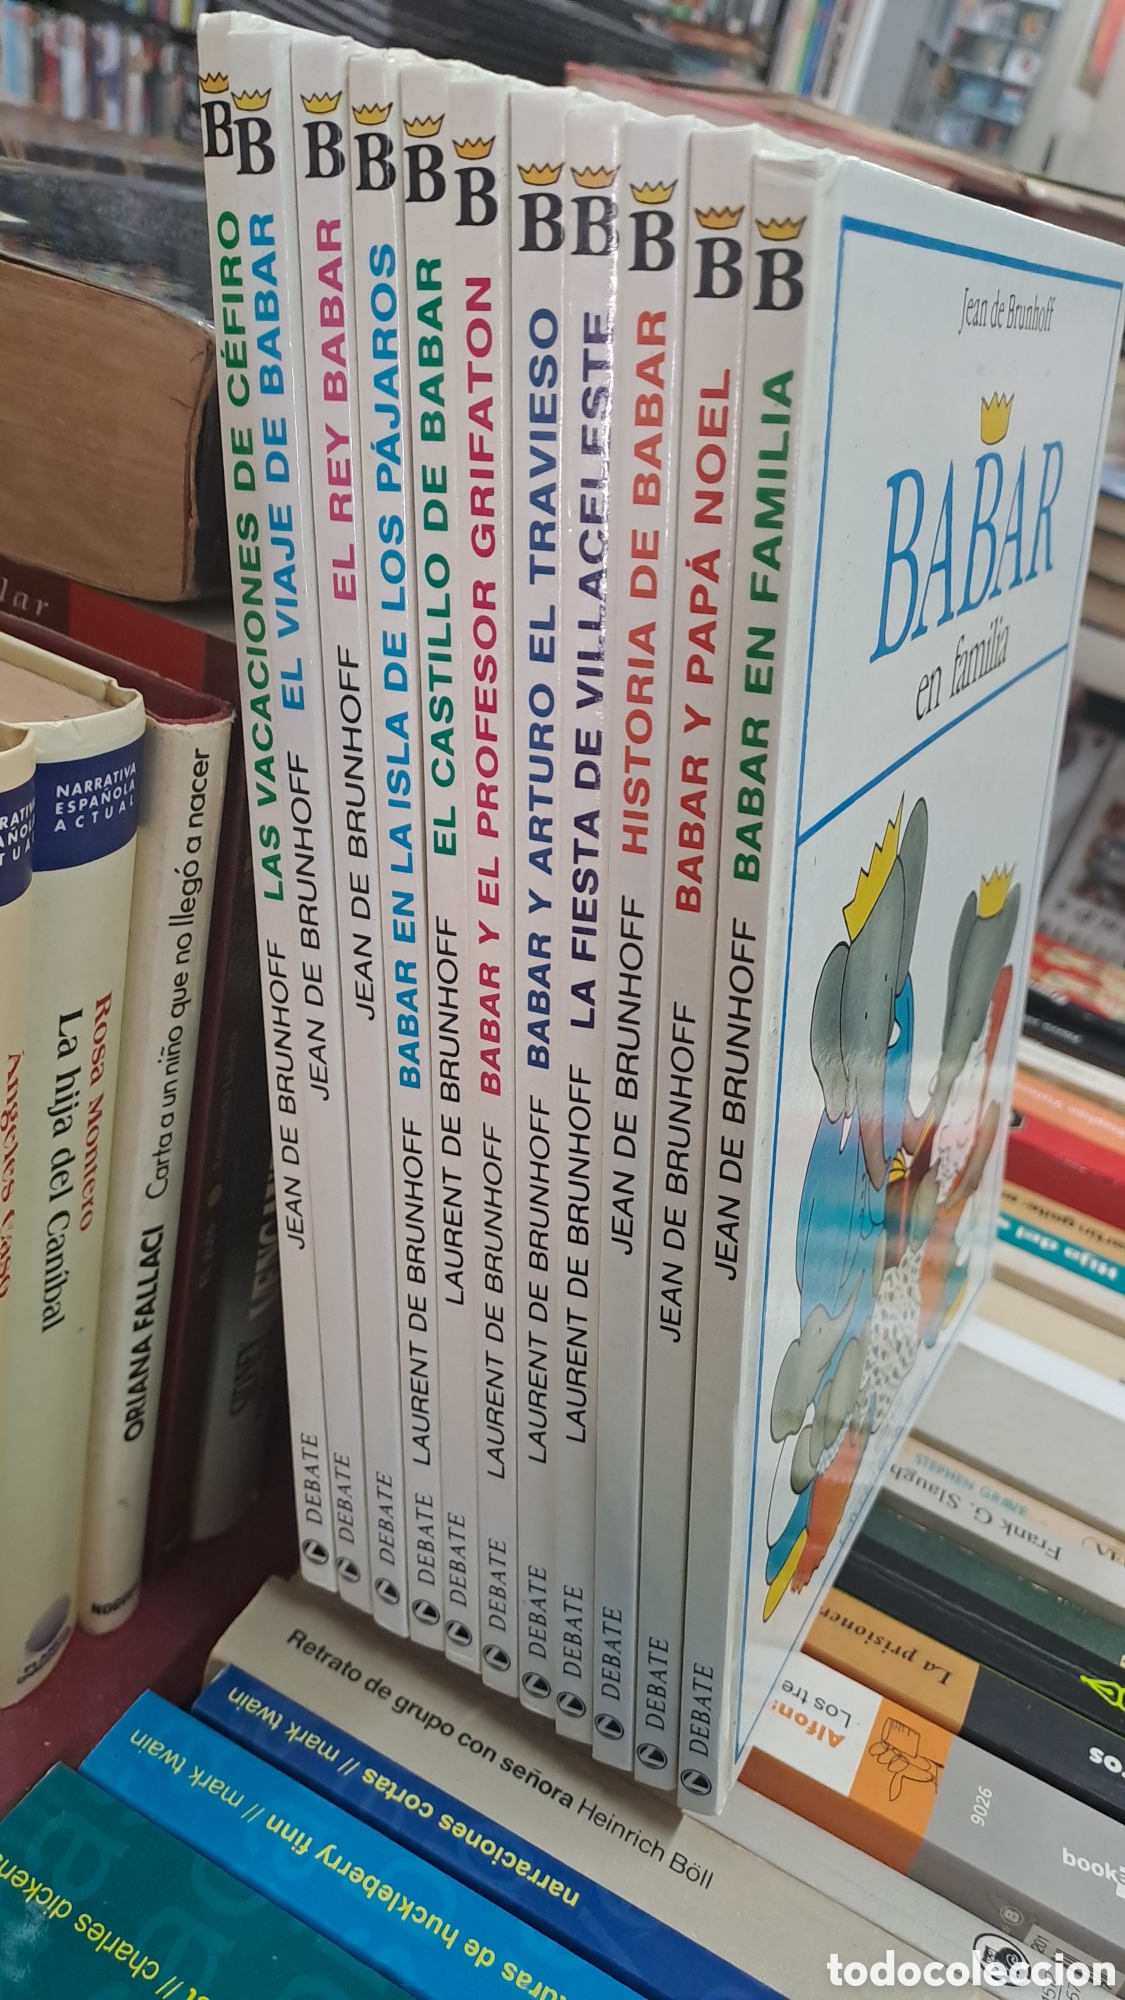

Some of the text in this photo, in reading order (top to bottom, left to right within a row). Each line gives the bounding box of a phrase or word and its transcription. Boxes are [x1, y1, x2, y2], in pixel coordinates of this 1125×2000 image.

[234, 118, 275, 175] B
[455, 167, 498, 226] B
[693, 237, 742, 298] B
[316, 218, 357, 601] EL REY BABAR
[957, 287, 1056, 336] Jean de Brunhoff
[217, 211, 285, 901] LAS VACACIONES DE CÉFIRO
[249, 213, 306, 711] EL VIAJE DE BABAR
[416, 258, 457, 856] EL CASTILLO DE BABAR
[622, 310, 666, 855] HISTORIA DE BABAR
[869, 440, 1064, 664] BABAR
[369, 244, 421, 1089] BABAR EN LA ISLA DE LOS PÁJAROS
[465, 277, 501, 1096] BABAR Y EL PROFESOR GRIFATON
[527, 308, 559, 1069] BABAR Y ARTURO EL TRAVIESO
[570, 312, 615, 1029] LA FIESTA DE VILLACELESTE
[676, 368, 730, 913] BABAR Y PAPÁ NOEL
[733, 369, 795, 882] BABAR EN FAMILIA
[915, 615, 1011, 722] en familia
[54, 794, 134, 832] ACTUAL
[55, 779, 135, 815] ESPAÑOLA
[56, 762, 136, 798] NARRATIVA
[337, 645, 375, 1021] JEAN DE BRUNHOFF
[57, 1009, 83, 1059] La
[287, 750, 329, 1101] JEAN DE BRUNHOFF
[47, 1066, 81, 1138] hija
[48, 1146, 75, 1203] del
[80, 989, 113, 1232] Rosa Montero
[124, 748, 209, 1441] ORIANA FALLACI Carta a un niño que no llegó a nacer
[266, 939, 305, 1250] JEAN DE BRUNHOFF
[436, 916, 464, 1305] LAURENT DE BRUNHOFF
[611, 894, 646, 1255] JEAN DE BRUNHOFF
[660, 1001, 696, 1343] JEAN DE BRUNHOFF
[714, 917, 758, 1280] JEAN DE BRUNHOFF
[402, 1117, 431, 1466] LAURENT DE BRUNHOFF
[482, 1122, 506, 1479] LAURENT DE BRUNHOFF
[528, 1095, 552, 1463] LAURENT DE BRUNHOFF
[565, 1064, 594, 1443] LAURENT DE BRUNHOFF
[301, 1432, 323, 1526] DEBATE
[376, 1471, 395, 1566] DEBATE
[448, 1512, 467, 1607] DEBATE
[970, 1502, 993, 1524] G.
[1001, 1517, 1062, 1561] Frank
[528, 1565, 547, 1659] DEBATE
[601, 1606, 622, 1701] DEBATE
[688, 1663, 714, 1757] DEBATE
[781, 1679, 852, 1729] Los tre
[923, 1660, 954, 1686] La
[130, 1728, 567, 2000] uras de huckleberry finn mark twain
[228, 1687, 580, 1909] narraciones cortas mark twain
[287, 1628, 714, 1891] Retrato de grupo con señora Heinrich Böll
[970, 1786, 994, 1828] 9026
[0, 1852, 161, 1982] charles dicken
